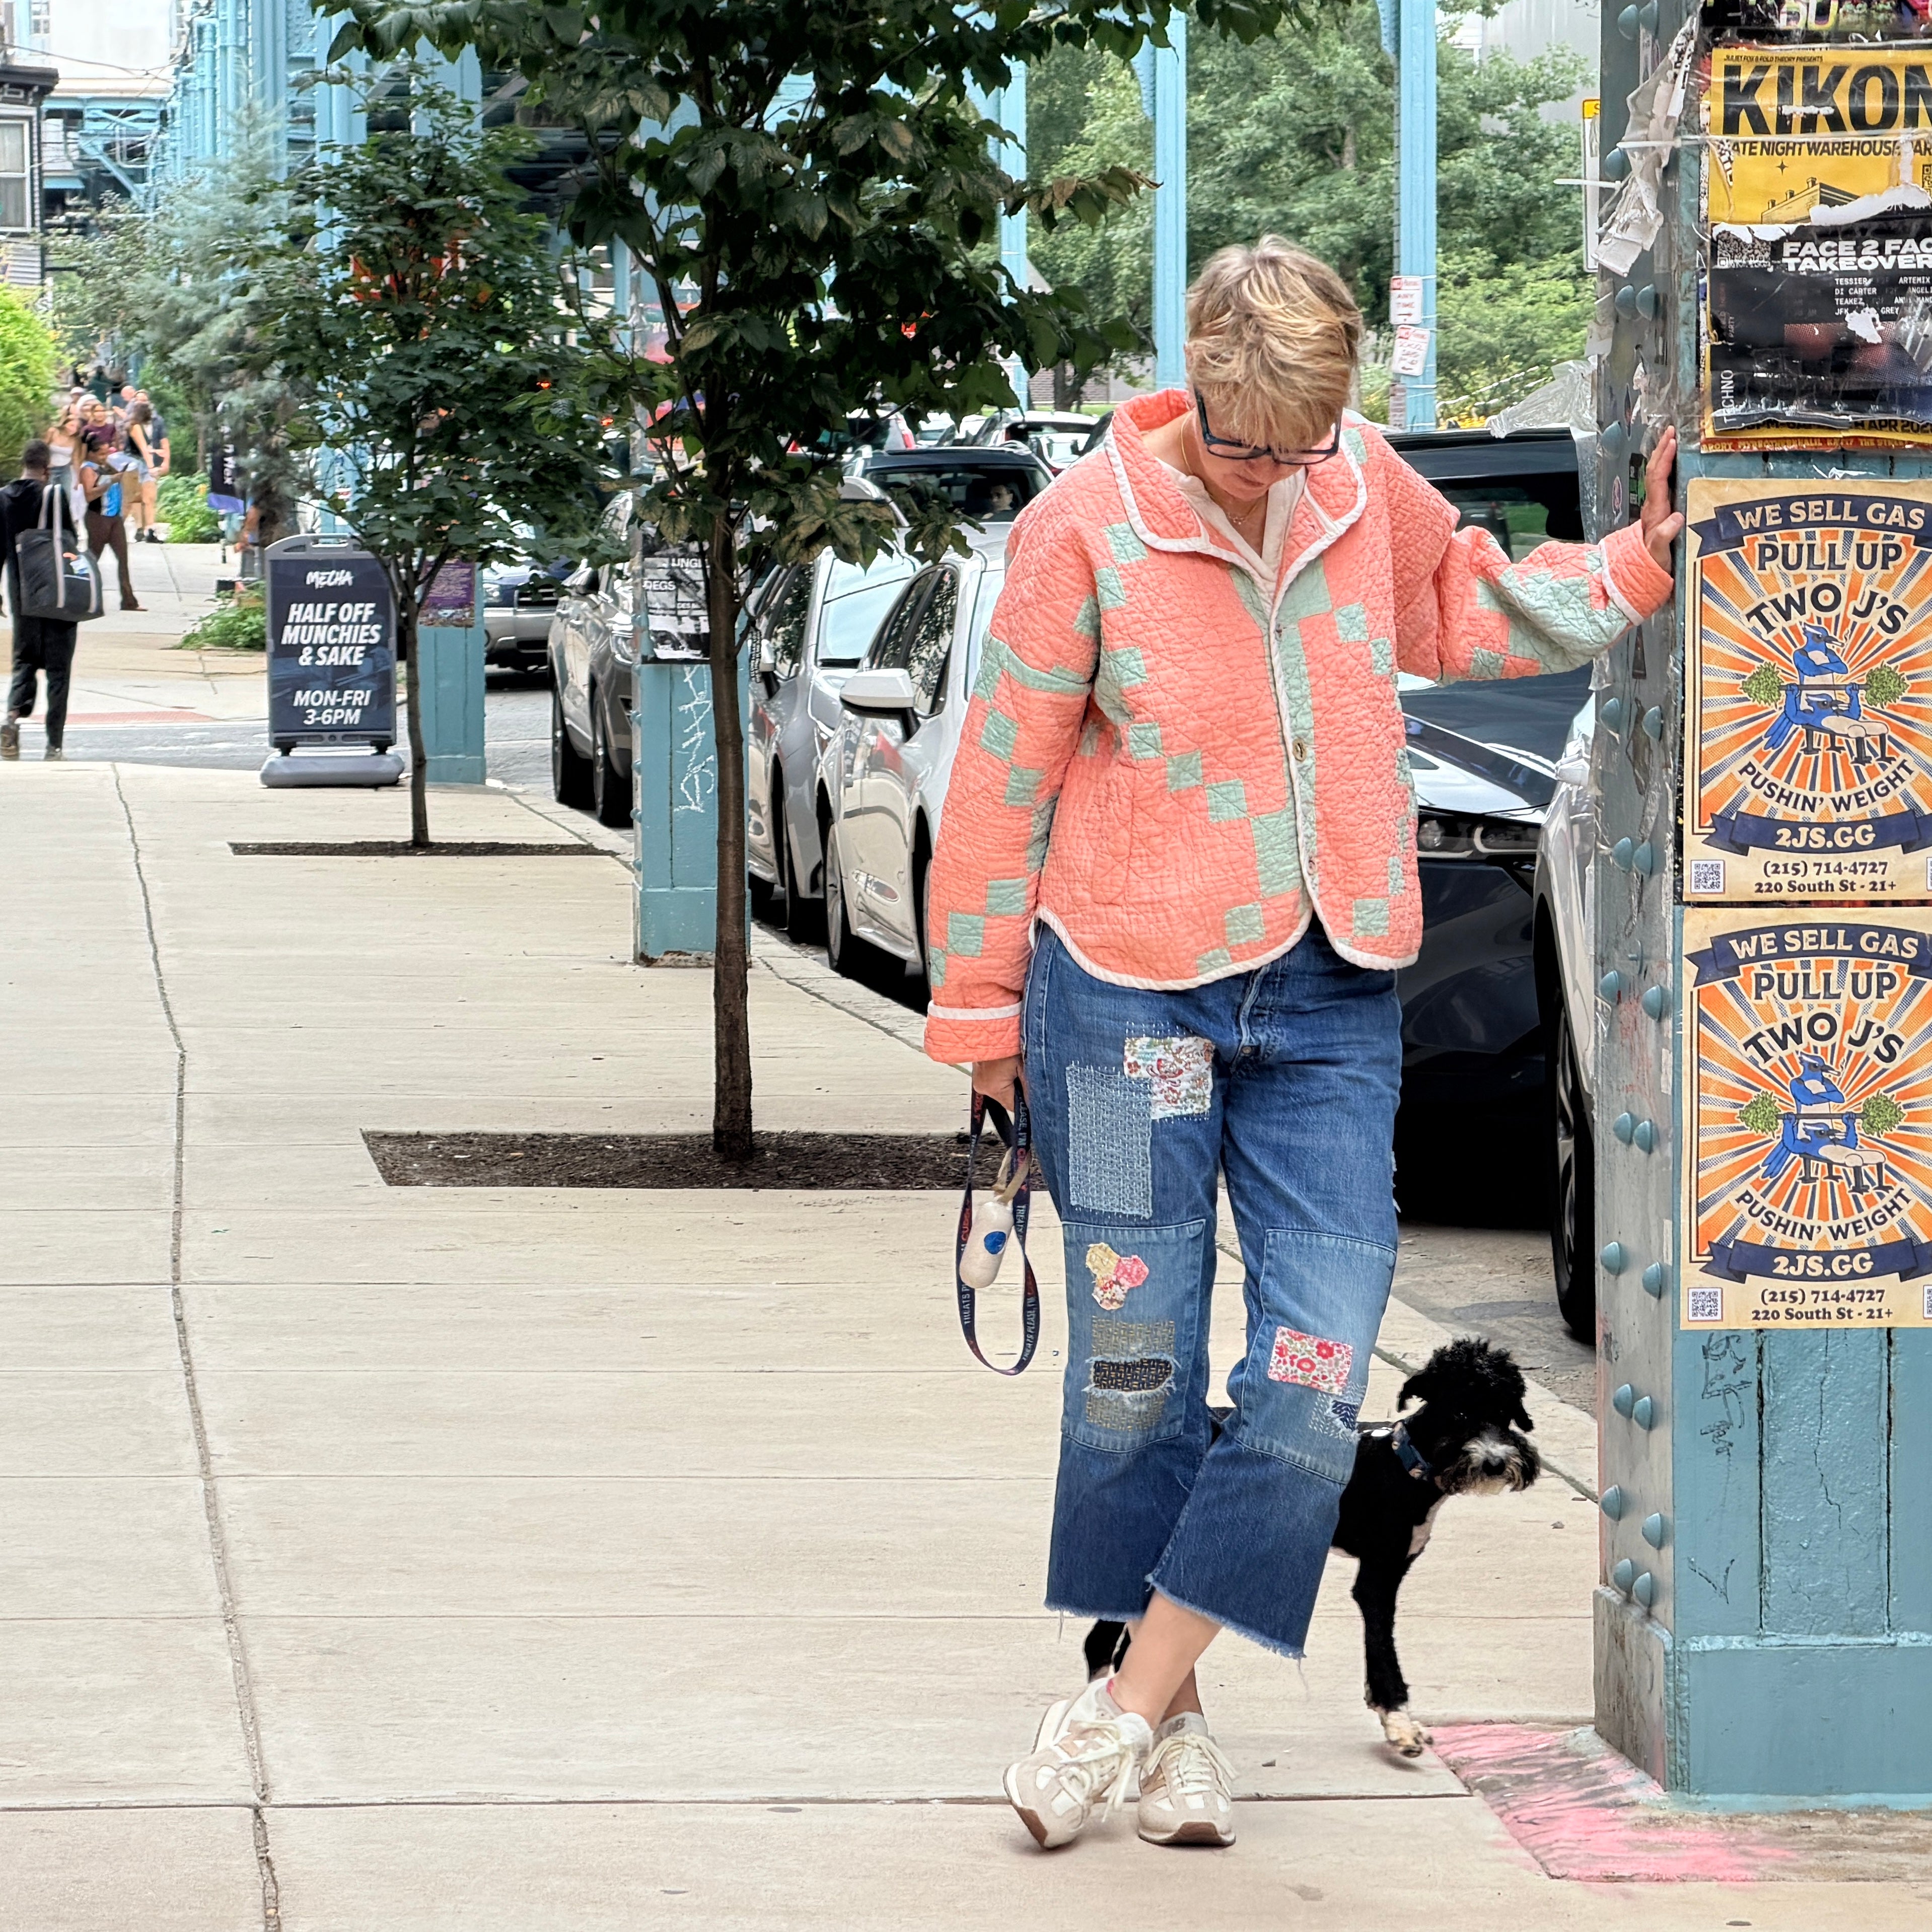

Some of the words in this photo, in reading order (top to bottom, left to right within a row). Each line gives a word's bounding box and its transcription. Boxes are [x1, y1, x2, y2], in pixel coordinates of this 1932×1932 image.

[1731, 141, 1757, 156] ATE
[1760, 141, 1804, 156] NIGHT
[1783, 240, 1856, 257] FACE
[1861, 239, 1879, 255] 2
[1781, 254, 1932, 272] TAKEOVER
[1880, 307, 1899, 315] GREY
[1868, 419, 1898, 433] APR
[1733, 504, 1782, 530] WE
[1789, 500, 1859, 522] SELL
[1866, 503, 1925, 530] GAS
[1758, 542, 1848, 571] PULL
[1856, 543, 1903, 570] UP
[306, 569, 354, 590] MECHA
[288, 603, 338, 623] HALF
[338, 603, 376, 622] OFF
[1746, 583, 1841, 635] TWO
[1852, 590, 1909, 634] J'S
[281, 624, 383, 645] MUNCHIES
[299, 648, 313, 666] &
[315, 646, 366, 666] SAKE
[294, 690, 372, 707] MON-FRI
[303, 708, 362, 725] 3-6PM
[1738, 761, 1825, 813] PUSHIN'
[1830, 759, 1915, 813] WEIGHT
[1775, 824, 1876, 848] 2JS.GG
[1763, 861, 1808, 878] (215)
[1813, 861, 1889, 876] 714-4727
[1754, 882, 1783, 893] 220
[1787, 880, 1835, 893] South
[1839, 879, 1856, 892] St
[1869, 880, 1897, 892] 21+
[1729, 933, 1778, 960] WE
[1784, 929, 1853, 951] SELL
[1860, 932, 1919, 959] GAS
[1754, 972, 1841, 1000] PULL
[1851, 972, 1897, 999] UP
[1743, 1012, 1837, 1063] TWO
[1848, 1019, 1904, 1063] J'S
[1735, 1190, 1822, 1241] PUSHIN'
[1828, 1188, 1913, 1241] WEIGHT
[1772, 1252, 1874, 1276] 2JS.GG
[1760, 1289, 1806, 1305] (215)
[1811, 1289, 1885, 1304] 714-4727
[1752, 1309, 1780, 1321] 220
[1784, 1307, 1832, 1321] South
[1836, 1307, 1853, 1320] St
[1866, 1308, 1893, 1319] 21+
